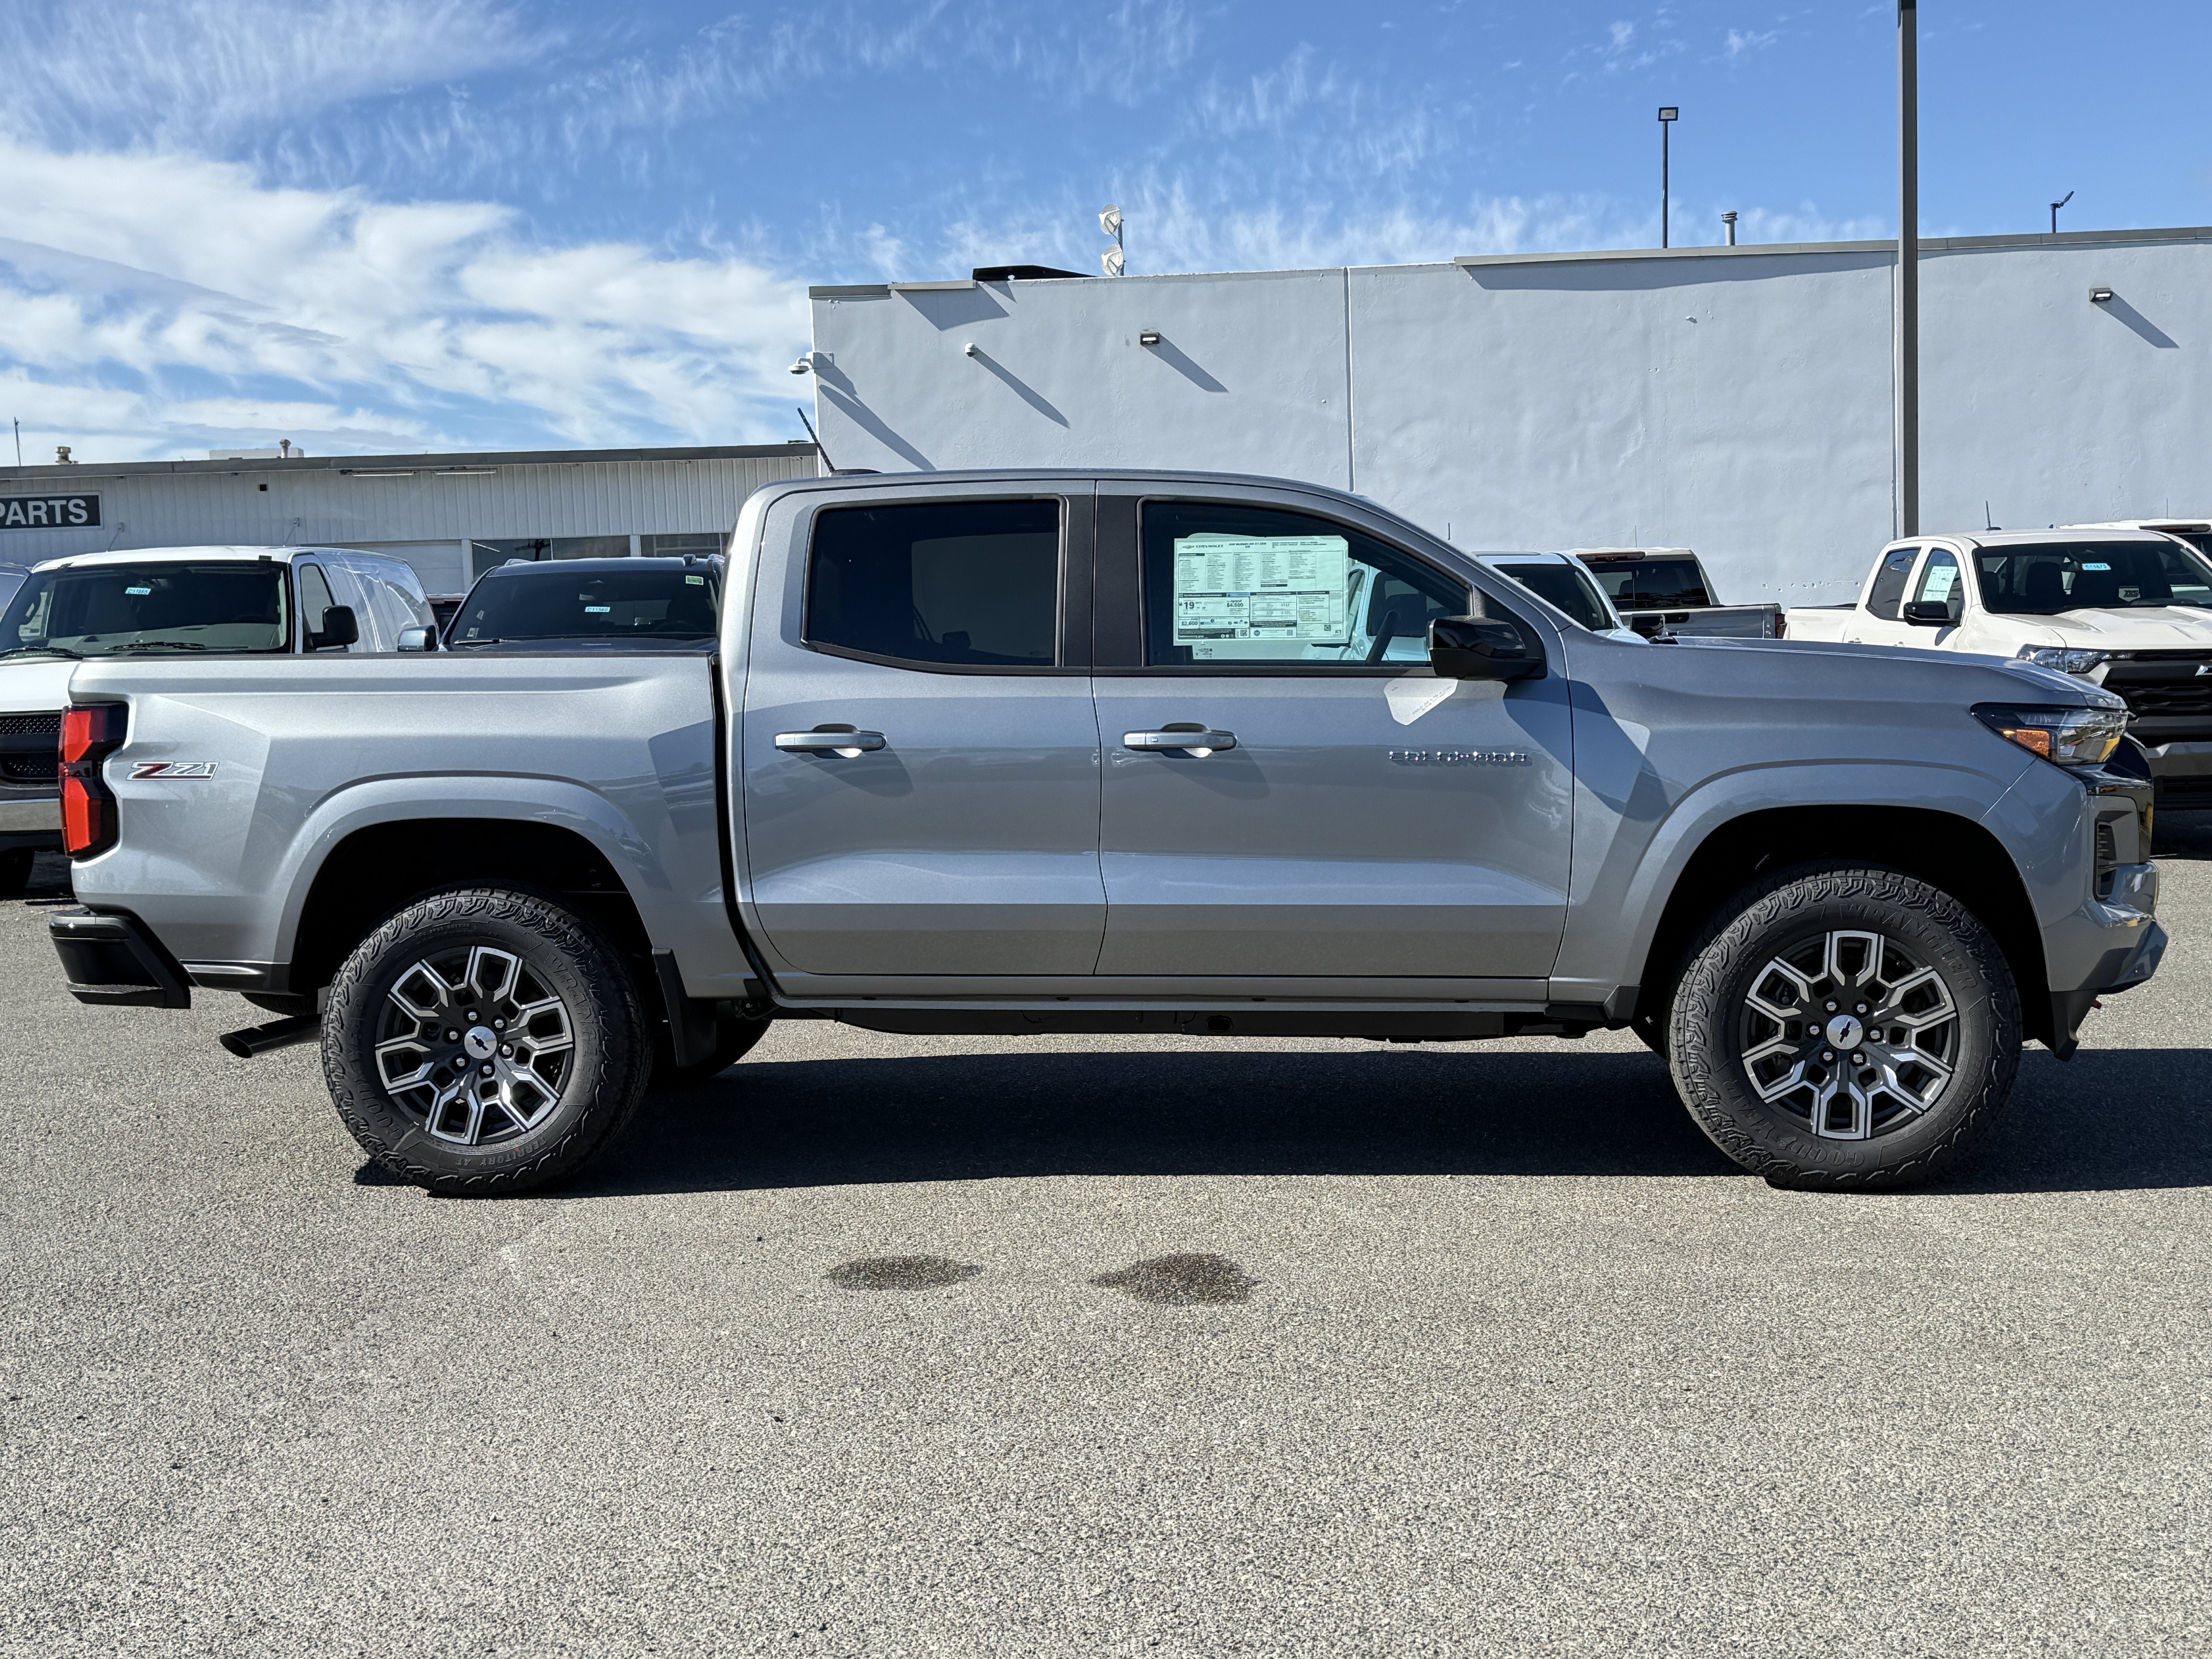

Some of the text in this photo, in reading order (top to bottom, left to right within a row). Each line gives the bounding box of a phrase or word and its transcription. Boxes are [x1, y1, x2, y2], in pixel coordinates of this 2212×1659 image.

[126, 761, 220, 781] Z71
[1389, 751, 1527, 762] COLORADO
[1839, 903, 1977, 991] WRANGLER
[544, 952, 598, 1093] WRANGLER
[1723, 1079, 1865, 1168] GOODYEAR
